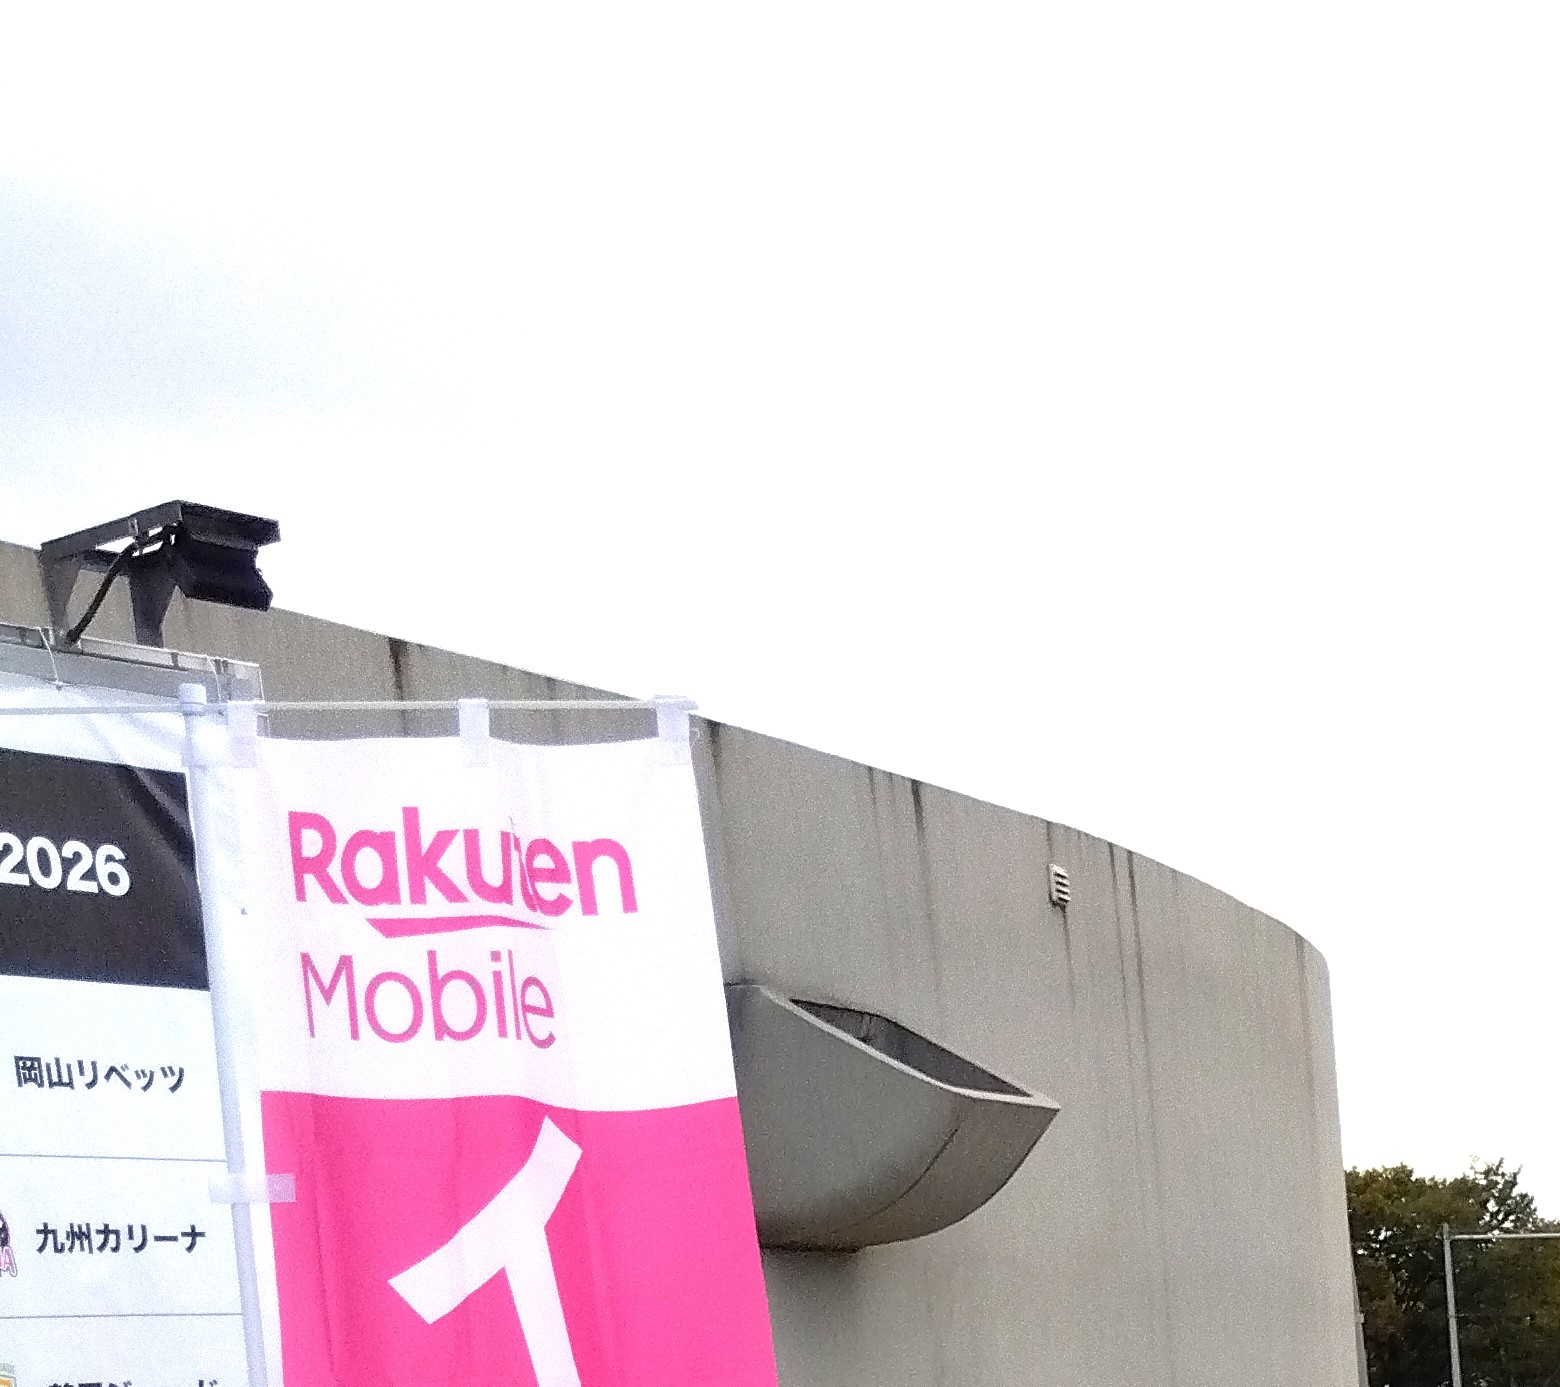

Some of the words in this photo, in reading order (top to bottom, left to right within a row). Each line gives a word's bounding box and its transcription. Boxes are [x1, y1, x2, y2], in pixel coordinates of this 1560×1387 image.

[0, 831, 131, 897] 2026
[299, 948, 558, 1050] Mobile
[13, 1055, 185, 1094] 岡山リベッツ
[35, 1221, 207, 1255] 九州カリーナ
